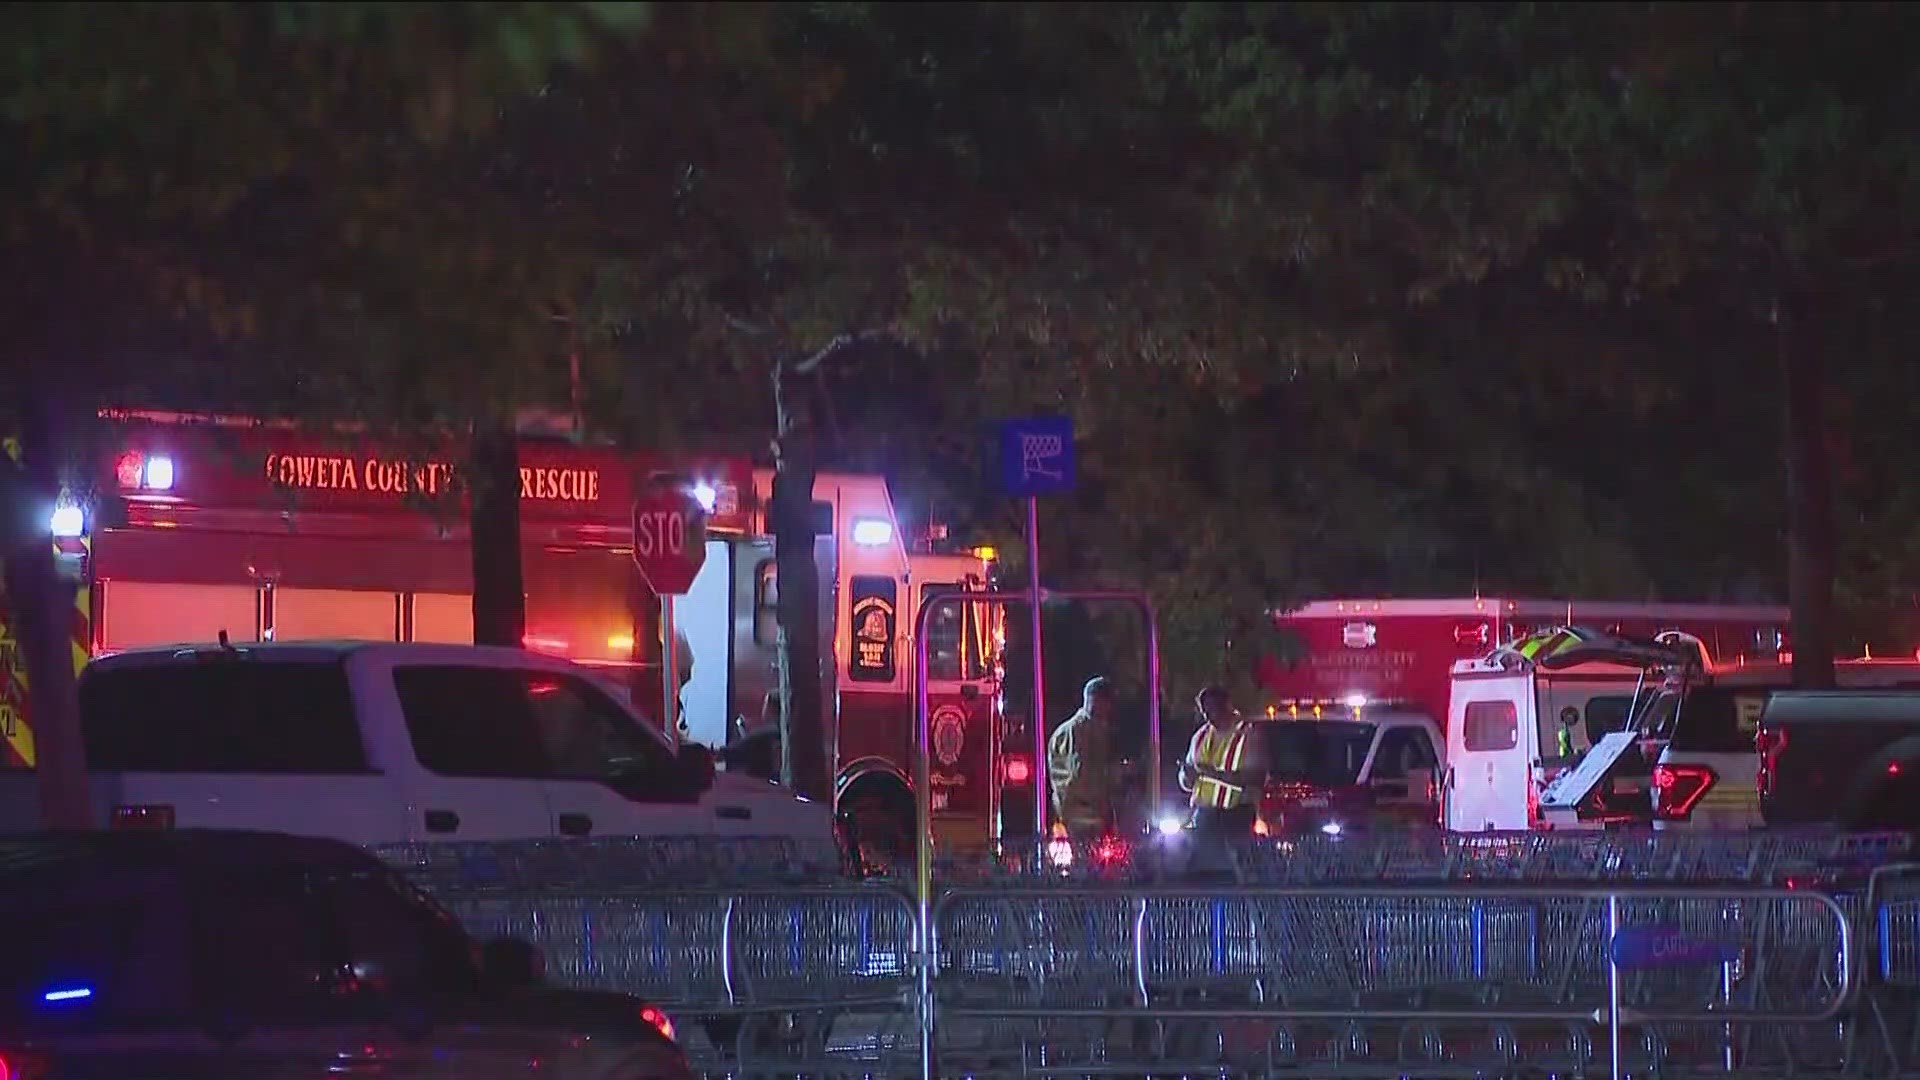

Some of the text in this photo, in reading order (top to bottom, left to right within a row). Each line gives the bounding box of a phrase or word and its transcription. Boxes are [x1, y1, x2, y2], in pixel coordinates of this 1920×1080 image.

[264, 454, 358, 490] COWETA
[519, 467, 599, 500] RESCUE
[639, 511, 684, 556] STO
